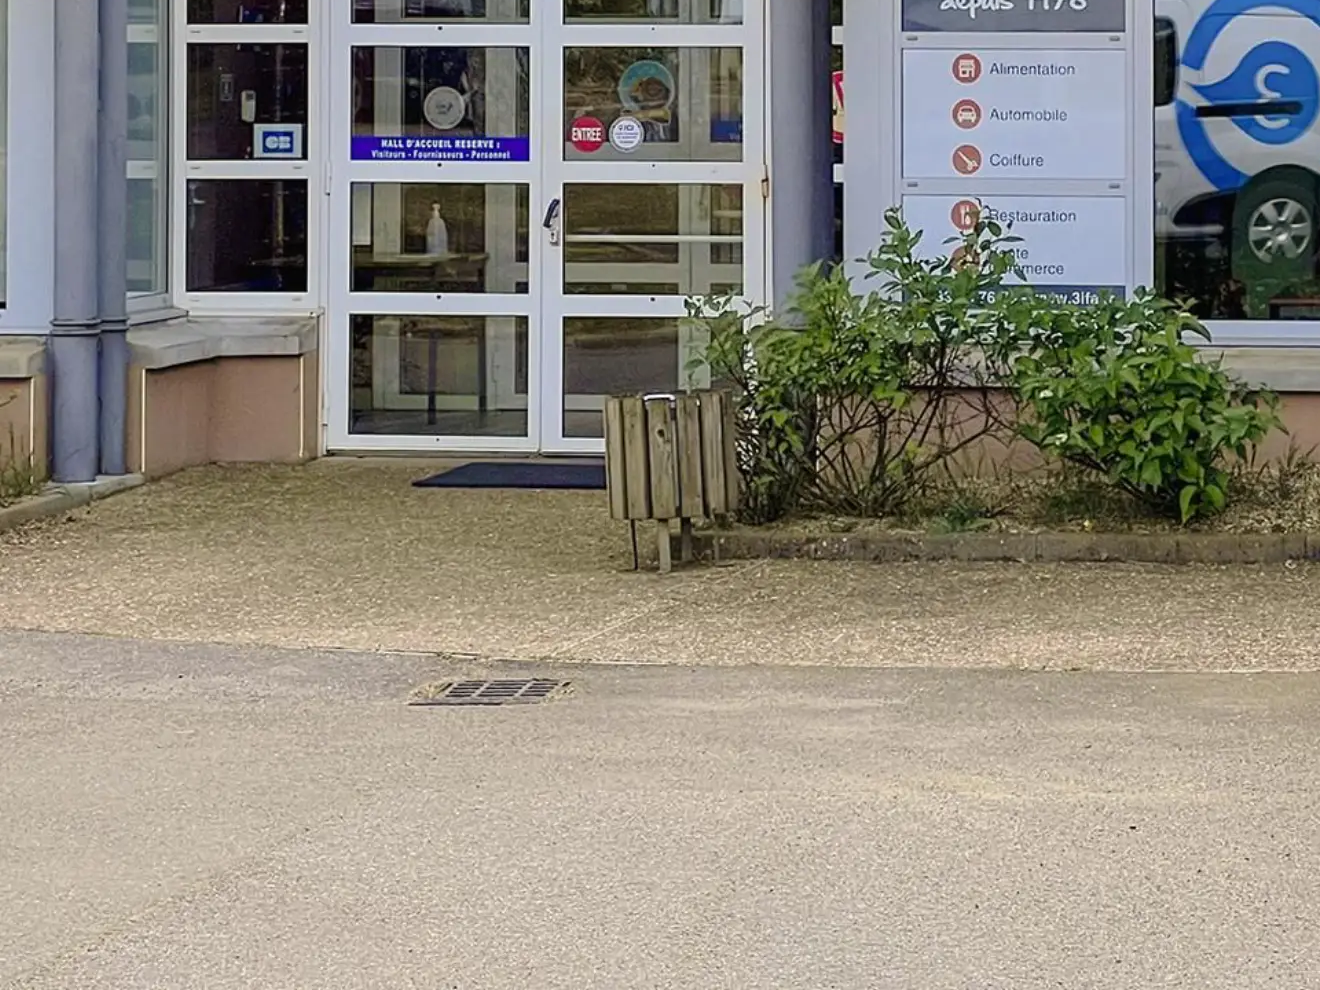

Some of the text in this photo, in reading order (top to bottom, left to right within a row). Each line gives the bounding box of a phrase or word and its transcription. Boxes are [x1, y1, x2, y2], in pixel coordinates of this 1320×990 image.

[989, 62, 1076, 76] Alimentation
[989, 109, 1068, 123] Automobile
[381, 139, 404, 148] HALL
[989, 154, 1044, 167] Coiffure
[990, 209, 1077, 223] Restauration
